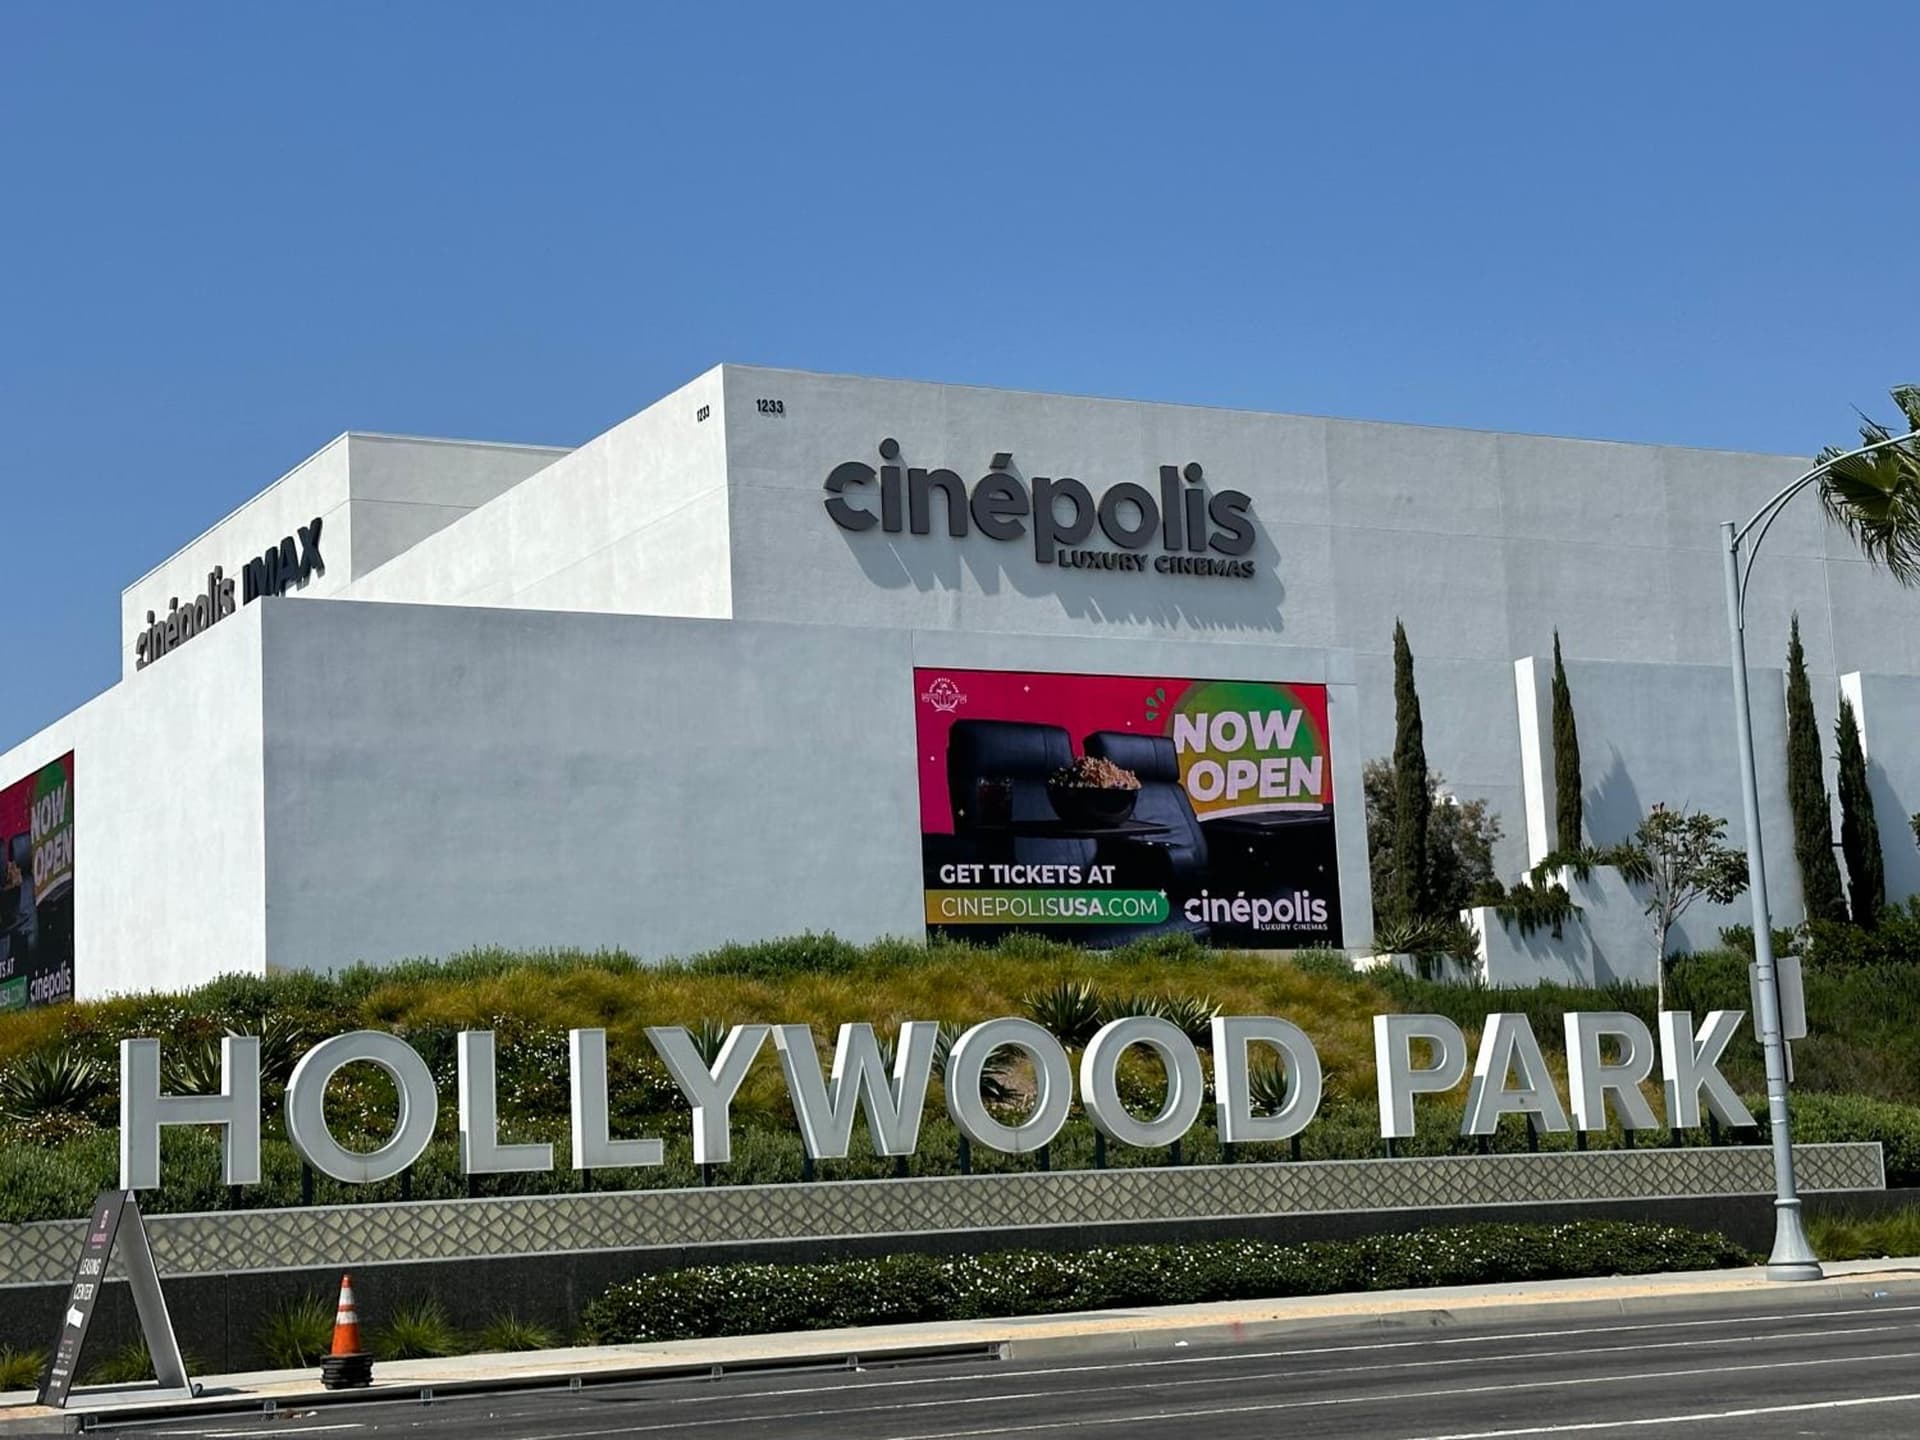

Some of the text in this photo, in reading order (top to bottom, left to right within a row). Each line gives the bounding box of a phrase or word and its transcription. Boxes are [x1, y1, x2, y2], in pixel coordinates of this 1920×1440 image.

[697, 405, 710, 422] 1233
[756, 399, 784, 414] 1233
[823, 437, 1257, 563] cinépolis
[242, 517, 325, 606] IMAX
[1058, 550, 1256, 579] LUXURY CINEMAS
[1172, 709, 1302, 754] NOW
[1187, 756, 1323, 802] OPEN
[31, 780, 67, 838] NOW
[34, 823, 72, 888] OPEN
[939, 864, 1116, 885] GET TICKETS AT
[941, 896, 1157, 918] CINEPOLISUSA.COM
[1184, 889, 1328, 930] cinépolis
[1260, 923, 1328, 931] LUXURY CINEMAS
[30, 960, 71, 1004] cinépolis
[119, 1010, 1758, 1191] HOLLYWOOD PARK
